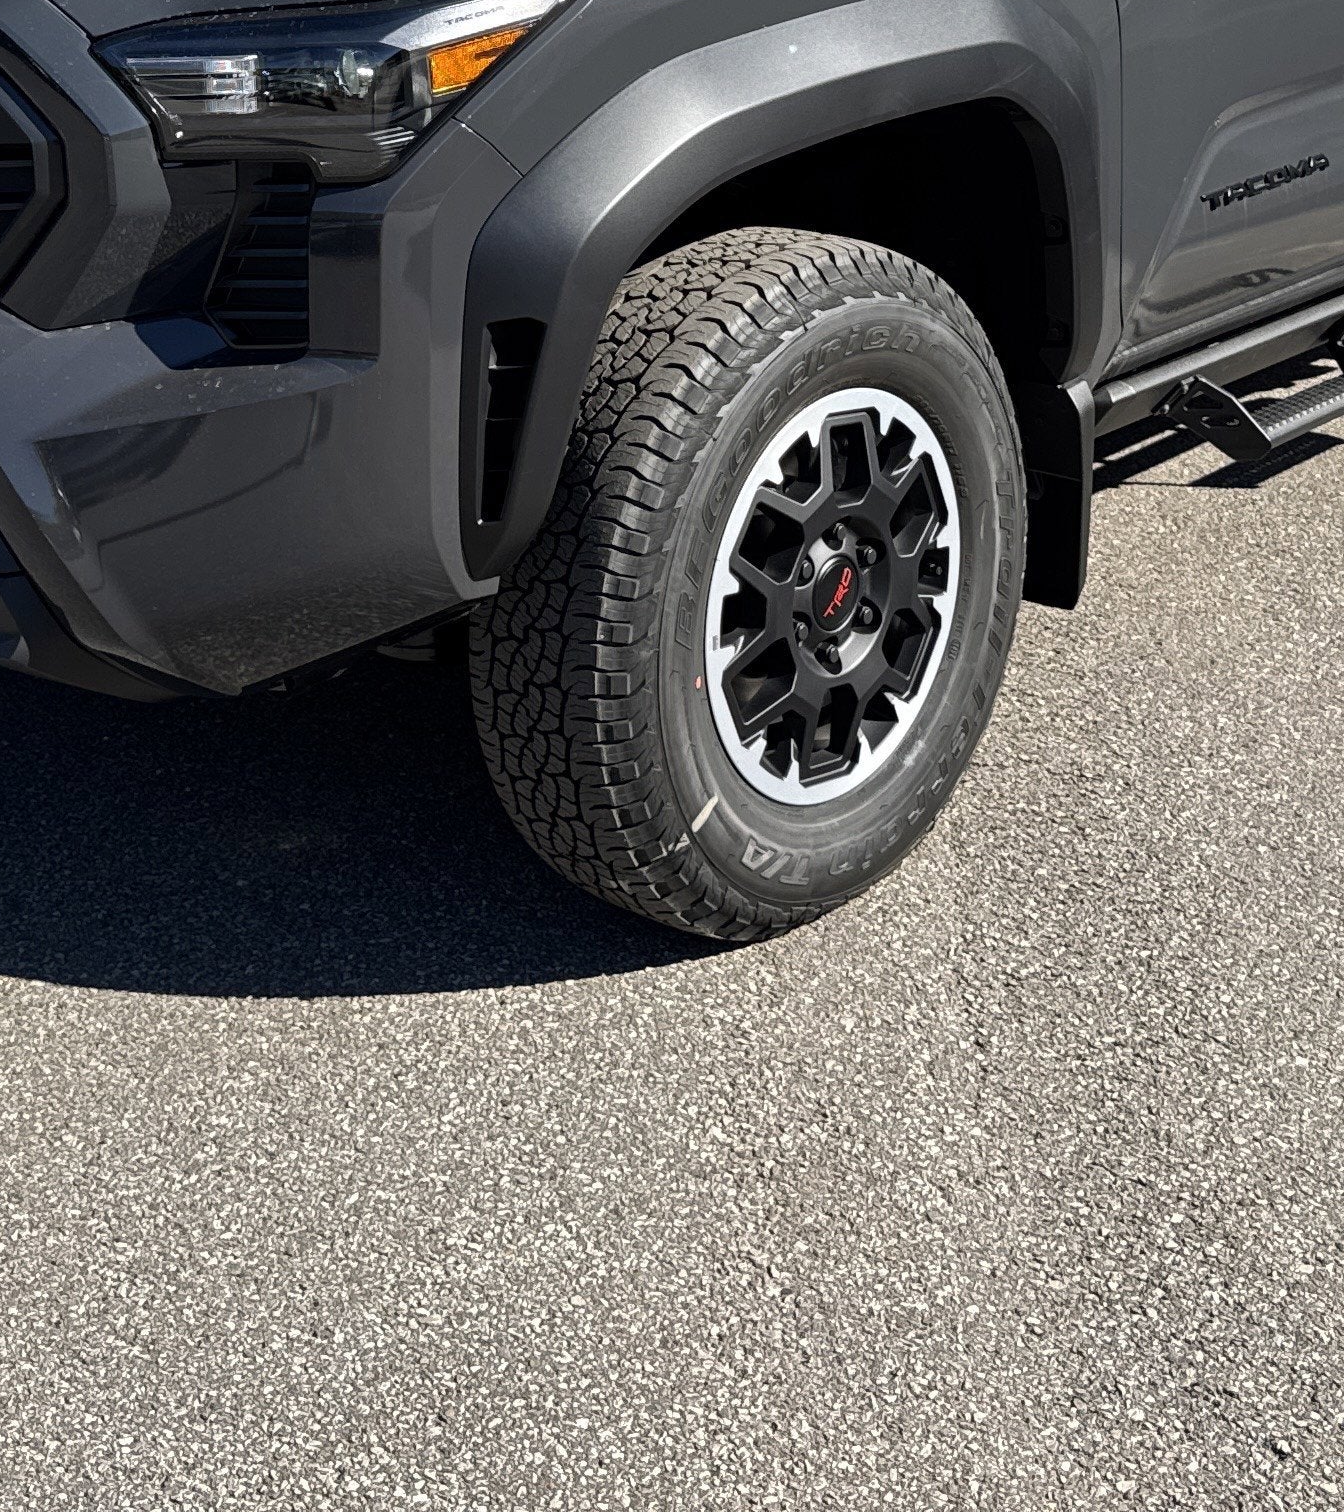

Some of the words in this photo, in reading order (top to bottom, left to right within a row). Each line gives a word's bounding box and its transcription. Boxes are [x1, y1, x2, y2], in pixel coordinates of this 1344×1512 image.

[443, 5, 505, 26] TACOMA
[1199, 153, 1330, 212] TACOMA
[822, 566, 852, 618] TRD
